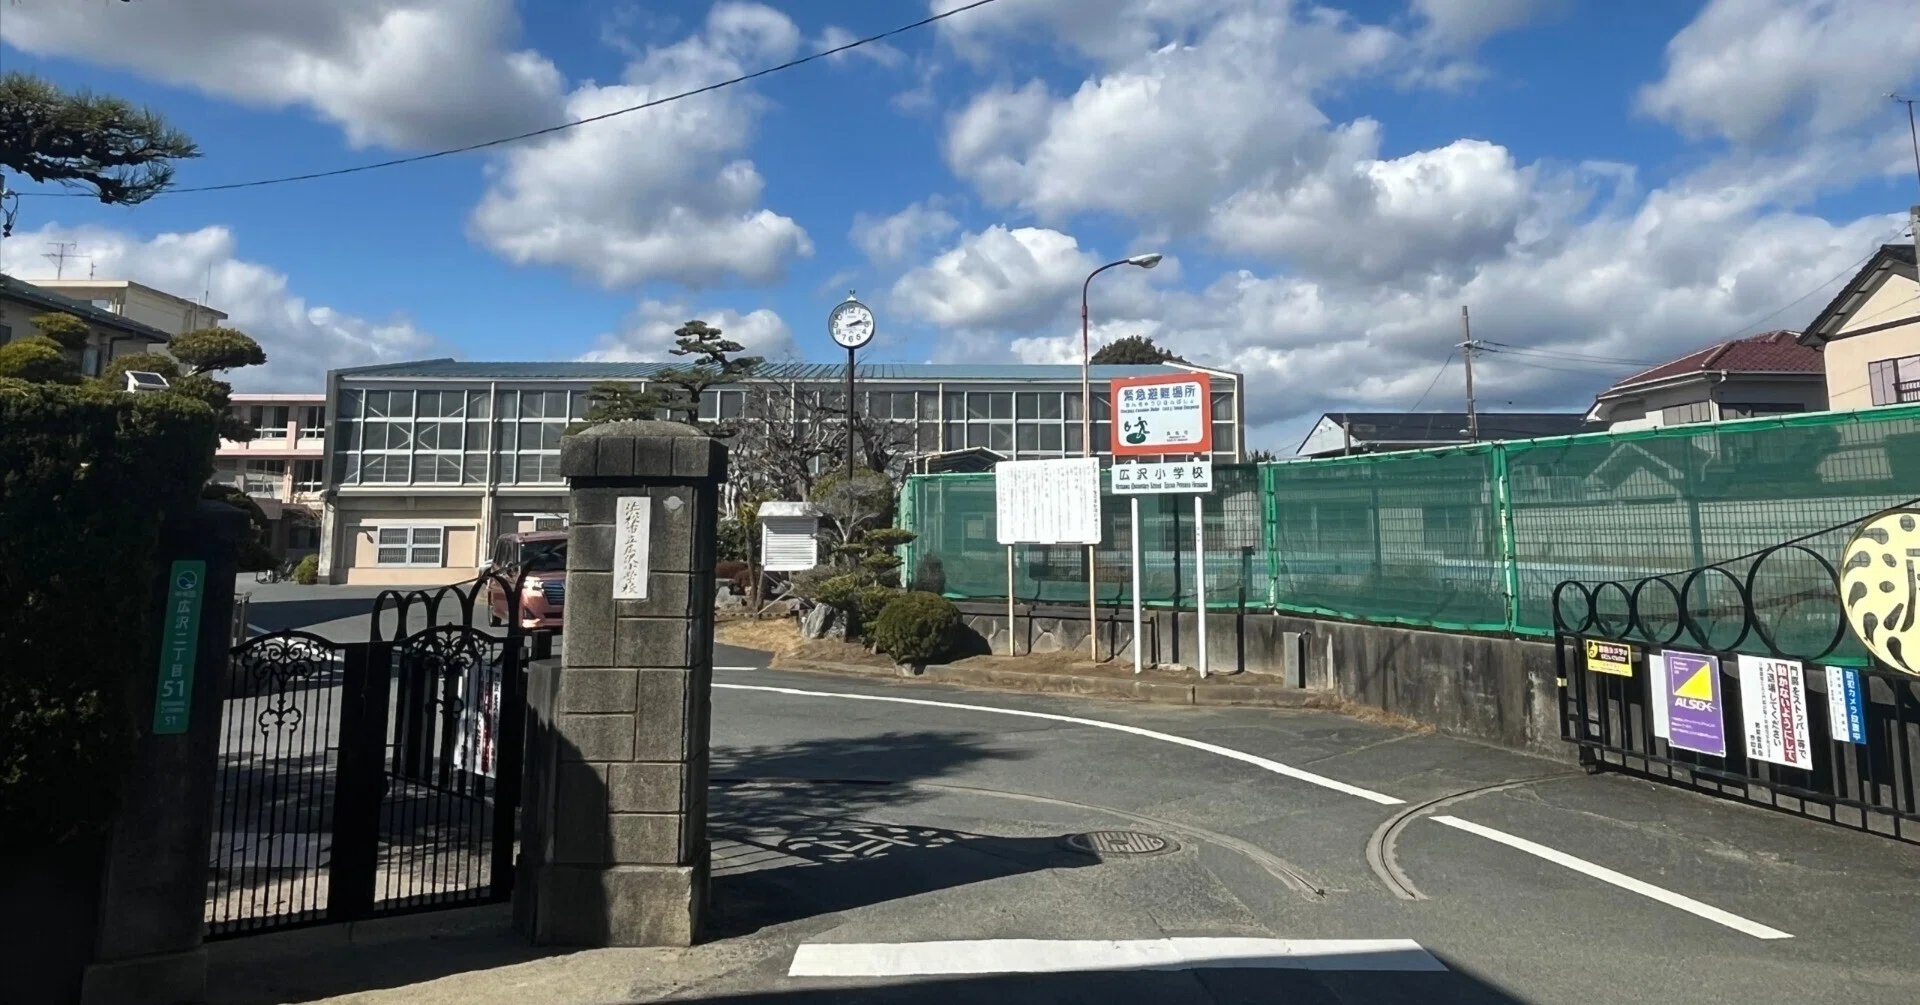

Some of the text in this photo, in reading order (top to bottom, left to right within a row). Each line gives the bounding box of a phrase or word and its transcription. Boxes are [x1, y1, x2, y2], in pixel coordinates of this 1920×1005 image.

[848, 335, 853, 343] 6
[1123, 384, 1196, 402] 緊急避難場所
[1119, 466, 1204, 480] 広沢小学校
[162, 680, 185, 697] 51
[1674, 697, 1717, 713] ALSOK
[1777, 664, 1795, 761] 動かないようにして
